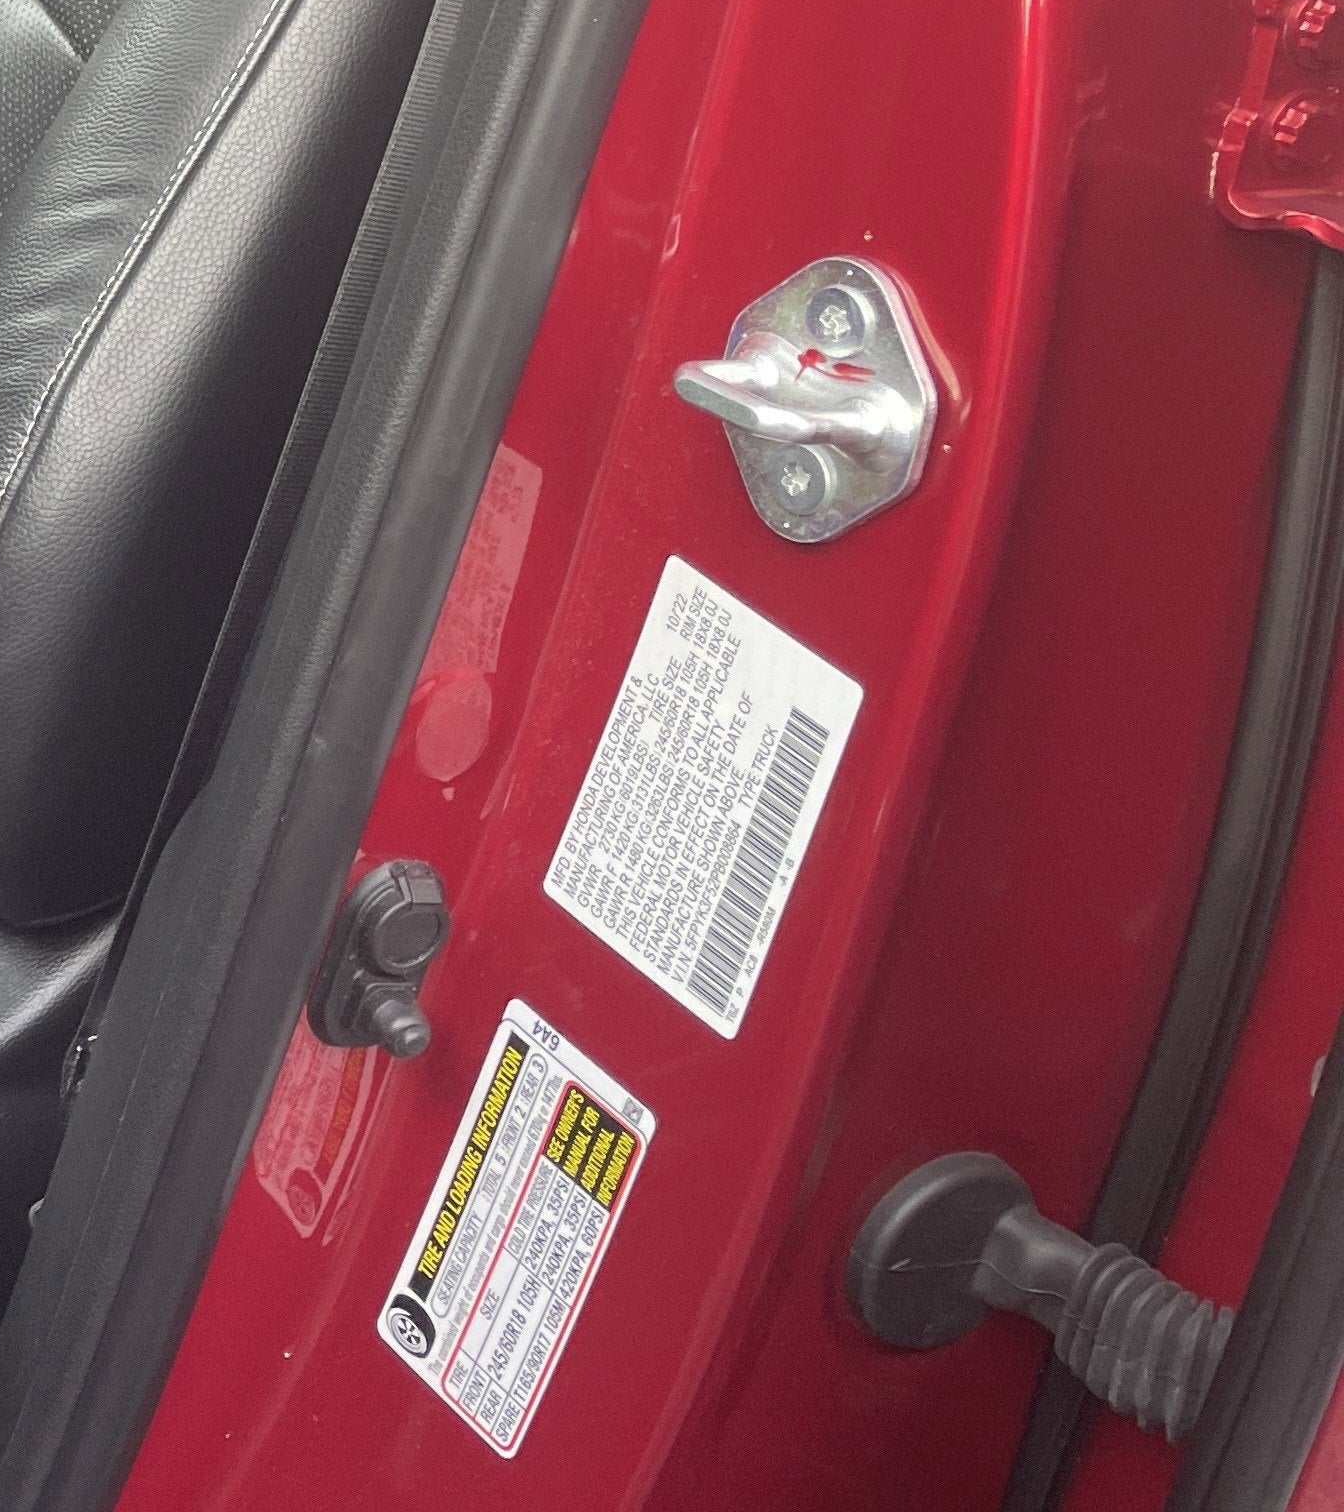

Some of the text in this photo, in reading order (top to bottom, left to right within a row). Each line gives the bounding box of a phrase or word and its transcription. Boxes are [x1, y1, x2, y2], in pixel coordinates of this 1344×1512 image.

[679, 586, 708, 641] RIM SIZE
[648, 655, 682, 723] TIRE SIZE
[680, 651, 700, 685] 105H
[693, 661, 713, 694] 105H
[654, 685, 687, 753] 245/60R18
[667, 696, 700, 763] 245/60R18
[564, 832, 579, 854] BY
[572, 786, 600, 835] HONDA
[591, 685, 637, 787] DEVELOPMENT
[630, 676, 643, 688] &
[751, 724, 778, 772] TRUCK
[563, 785, 616, 899] MANUFACTURING
[609, 763, 623, 785] OF
[641, 673, 659, 702] LLC
[615, 633, 741, 939] THIS VEHICLE CONFORMS TO ALL APPLICABLE
[598, 821, 618, 854] 2730
[611, 831, 631, 862] 1420
[629, 719, 725, 952] FEDERAL MOTOR VEHICLE SAFETY
[643, 690, 753, 963] STANDARDS IN EFFECT ON THE DATE OF
[606, 862, 617, 877] F
[619, 873, 633, 887] R
[624, 842, 644, 872] 1480
[577, 864, 602, 908] GVWR
[590, 875, 615, 919] GAWR
[603, 885, 628, 929] GAWR
[656, 869, 705, 975] MANUFACTURE
[696, 815, 726, 872] SHOWN
[532, 1019, 560, 1051] 6A4
[520, 1060, 544, 1103] REAR 3
[501, 1105, 526, 1150] FRONT 2
[546, 1090, 584, 1162] SEE OWNER'S
[563, 1105, 600, 1177] MANUAL FOR
[418, 1240, 442, 1278] TIRE
[432, 1210, 456, 1248] AND
[446, 1145, 483, 1215] LOADING
[471, 1046, 522, 1150] INFORMATION
[481, 1168, 502, 1197] TOTAL
[494, 1153, 506, 1166] 5
[580, 1128, 615, 1191] ADDITIONAL
[596, 1132, 634, 1206] INFORMATION
[508, 1161, 553, 1255] COLD TIRE PRESSURE
[525, 1175, 570, 1270] 240KPA, 35PSI
[437, 1260, 462, 1305] SEATING
[454, 1210, 482, 1264] CAPACITY
[542, 1191, 587, 1286] 240KPA, 35PSI
[559, 1205, 605, 1299] 420KPA, 60PSI
[480, 1288, 500, 1320] SIZE
[487, 1274, 541, 1381] 245/60R18 105H
[544, 1299, 566, 1334] 105M
[449, 1360, 468, 1389] TIRE
[462, 1370, 486, 1412] FRONT
[480, 1390, 502, 1424] REAR
[495, 1401, 520, 1442] SPARE
